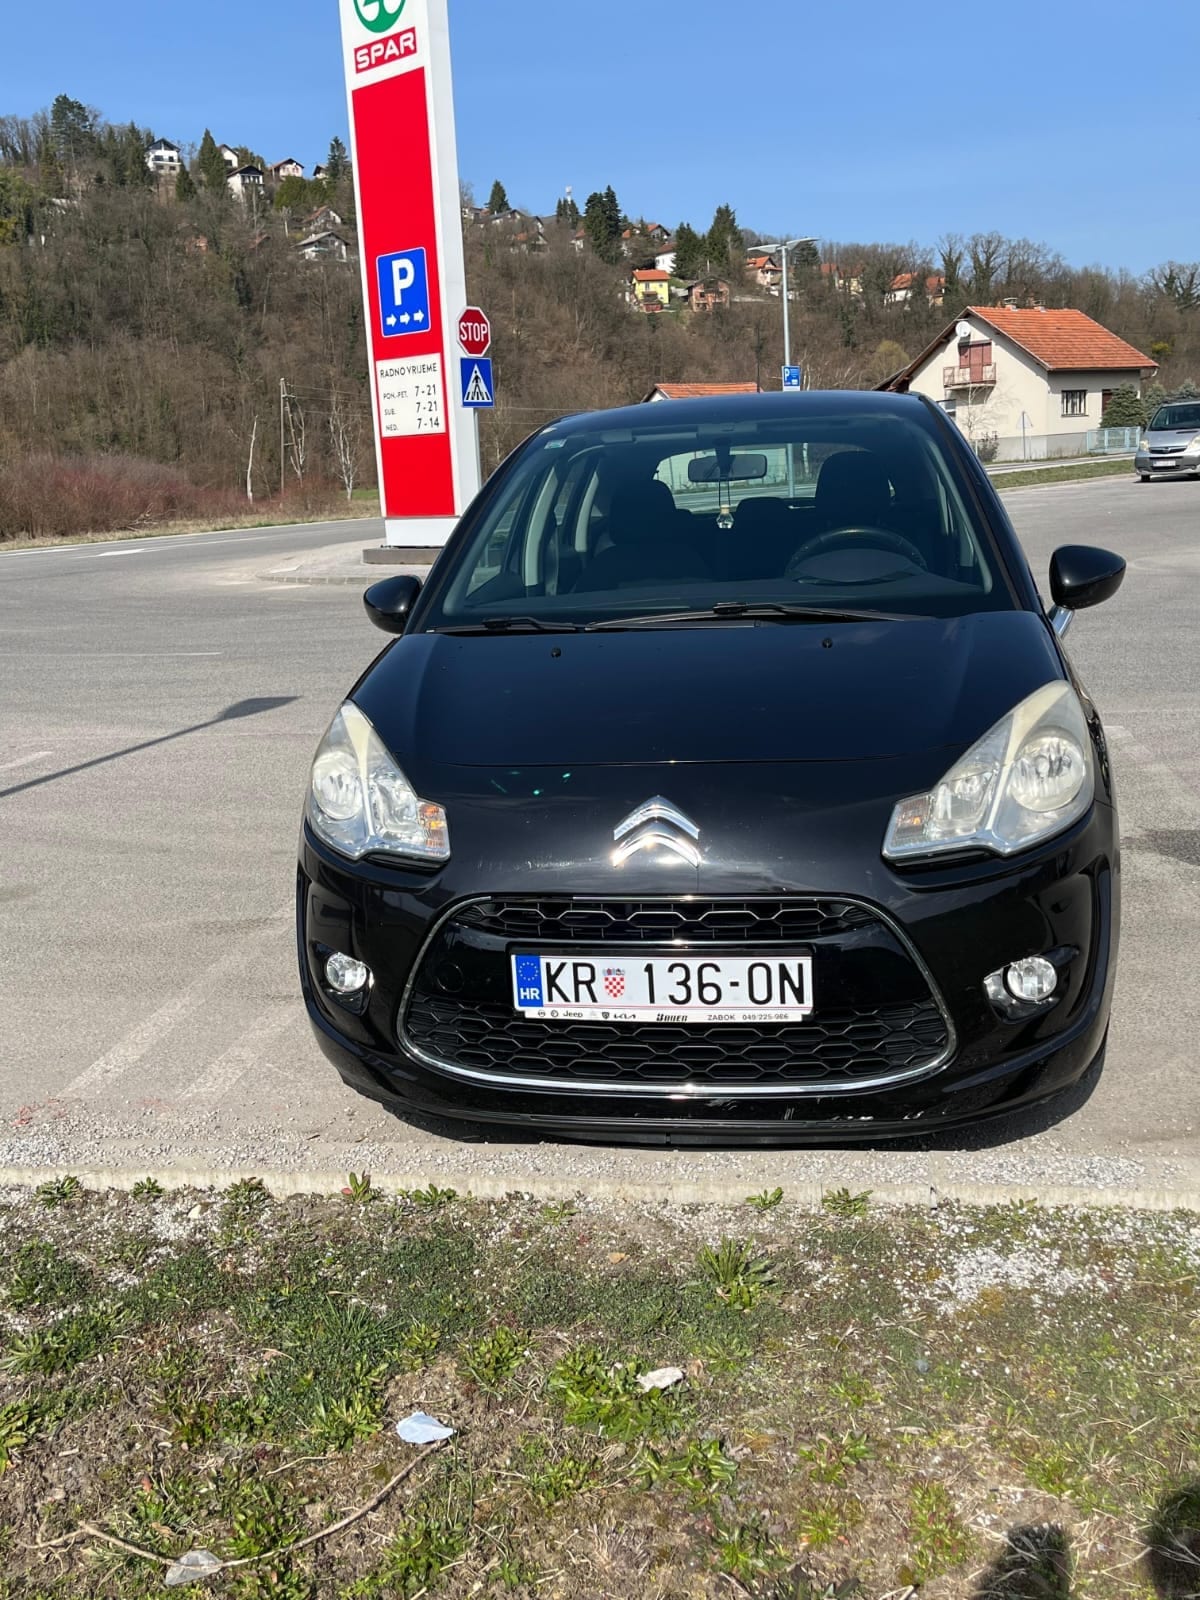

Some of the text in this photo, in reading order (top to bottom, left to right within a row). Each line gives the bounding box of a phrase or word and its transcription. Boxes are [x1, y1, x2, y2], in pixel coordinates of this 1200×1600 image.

[356, 31, 415, 70] SPAR
[391, 258, 415, 306] P
[460, 321, 488, 342] STOP
[380, 362, 438, 378] RADNO VRIJEME
[545, 961, 806, 1005] KR 136-ON
[519, 987, 540, 1001] HR
[562, 1010, 583, 1018] Jeep
